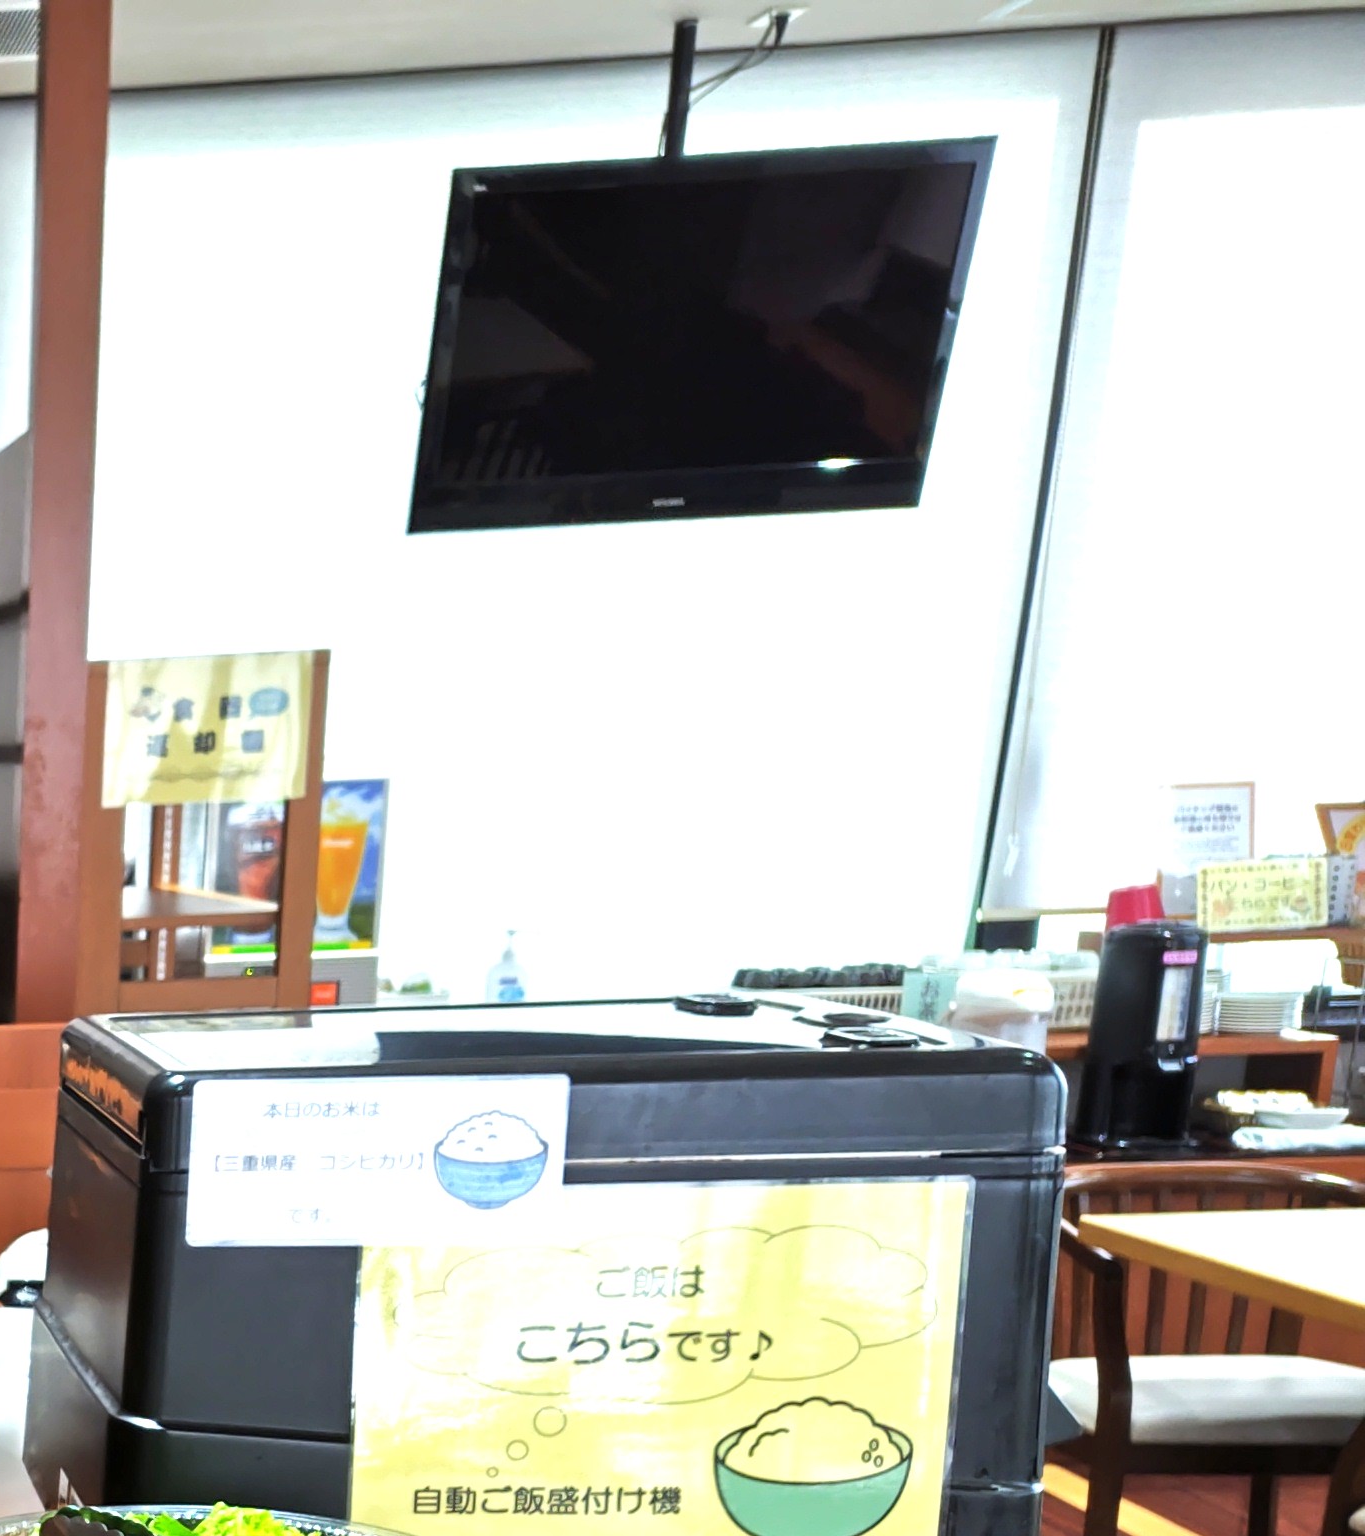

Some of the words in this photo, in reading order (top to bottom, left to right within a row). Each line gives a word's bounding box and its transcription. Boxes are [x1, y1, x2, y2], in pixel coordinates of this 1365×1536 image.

[263, 1100, 381, 1119] 本日のお米は
[596, 1265, 705, 1299] ご飯は
[413, 1486, 681, 1515] 自動ご飯盛付け機
